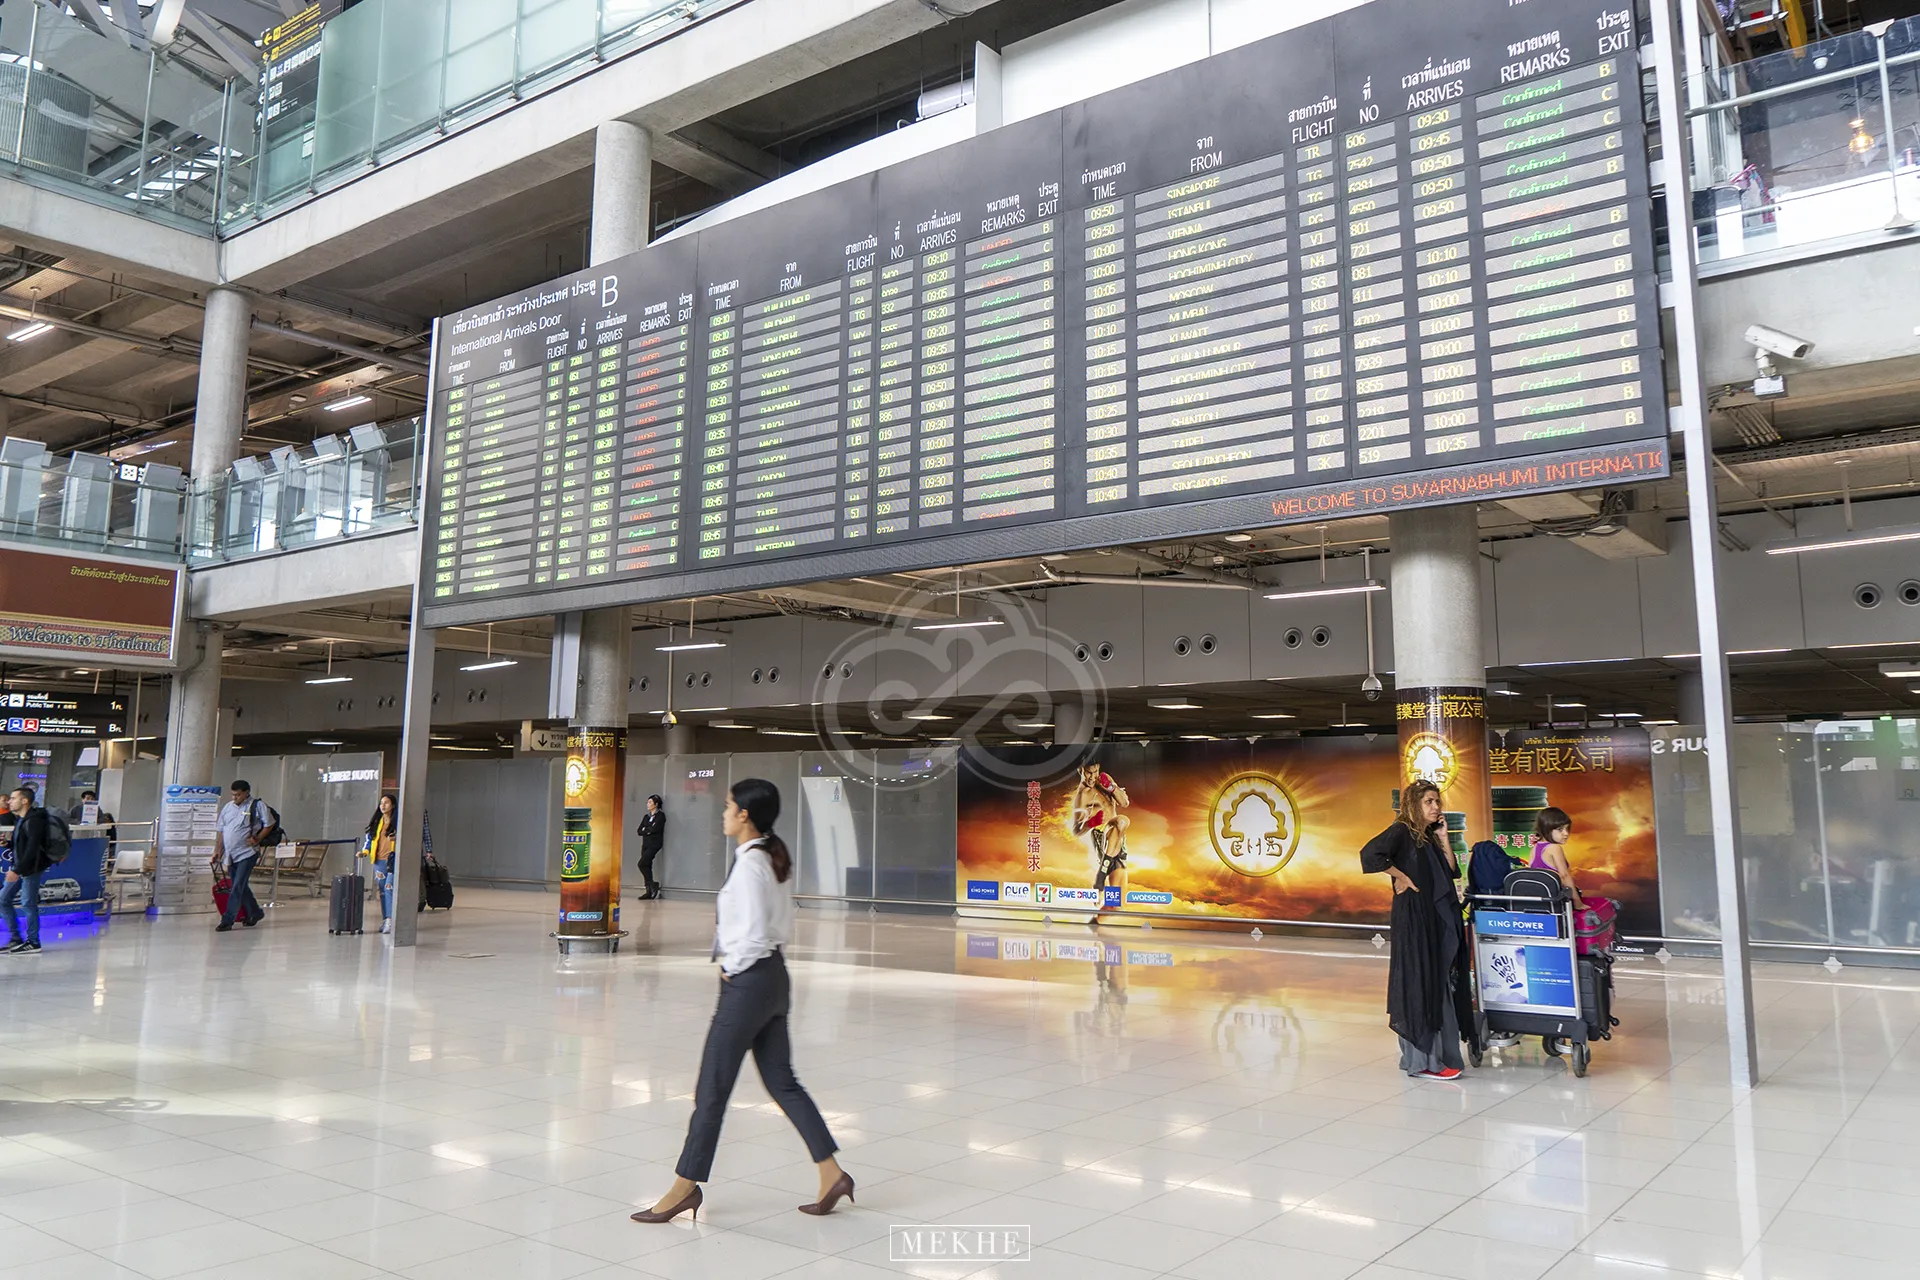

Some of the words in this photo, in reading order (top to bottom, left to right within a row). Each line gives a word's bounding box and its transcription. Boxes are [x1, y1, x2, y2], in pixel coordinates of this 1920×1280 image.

[1596, 9, 1630, 30] ประตู
[1507, 30, 1560, 58] หมายเหตุ
[1598, 30, 1631, 55] EXIT
[1500, 48, 1570, 84] REMARKS
[1406, 80, 1464, 110] ARRIVES
[1288, 95, 1337, 123] สายการบิน
[1359, 104, 1379, 124] NO
[1292, 117, 1334, 144] FLIGHT
[1090, 204, 1114, 221] 09:50
[1304, 146, 1320, 160] TR
[1346, 134, 1366, 149] 606
[1417, 110, 1449, 128] 09:30
[1599, 63, 1610, 78] B
[1196, 136, 1213, 150] จาก
[1090, 224, 1114, 240] 09:50
[1418, 132, 1450, 150] 09:45
[1601, 86, 1612, 101] C
[1190, 151, 1222, 172] FROM
[1038, 182, 1058, 198] ประตู
[1092, 244, 1115, 259] 10:00
[1419, 155, 1452, 173] 09:50
[1603, 111, 1614, 125] C
[1093, 182, 1116, 200] TIME
[1038, 199, 1059, 217] EXIT
[1092, 264, 1116, 279] 10:00
[1421, 178, 1453, 196] 09:50
[1605, 135, 1615, 149] C
[982, 209, 1026, 234] REMARKS
[1093, 284, 1116, 299] 10:05
[1350, 221, 1370, 237] 801
[1422, 200, 1454, 219] 09:50
[1607, 159, 1618, 174] B
[920, 229, 956, 251] ARRIVES
[890, 244, 904, 260] NO
[927, 253, 948, 266] 09:10
[847, 253, 876, 272] FLIGHT
[927, 271, 948, 284] 09:20
[1094, 324, 1116, 338] 10:10
[1427, 247, 1457, 264] 10:10
[1610, 209, 1621, 223] B
[572, 279, 596, 297] ประตู
[602, 275, 619, 308] B
[780, 275, 802, 292] FROM
[715, 295, 731, 310] TIME
[927, 289, 948, 302] 09:05
[678, 307, 693, 321] EXIT
[1093, 304, 1116, 319] 10:10
[1094, 345, 1116, 358] 10:15
[1427, 270, 1458, 286] 10:10
[640, 314, 670, 332] REMARKS
[452, 333, 502, 356] International
[504, 320, 537, 341] Arrivals
[540, 314, 562, 330] Door
[578, 338, 587, 350] NO
[597, 328, 623, 345] ARRIVES
[547, 344, 567, 359] FLIGHT
[500, 359, 516, 373] FROM
[452, 373, 465, 385] TIME
[1094, 488, 1118, 502] 10:40
[1436, 436, 1467, 453] 10:35
[1272, 492, 1355, 516] WELCOME
[1362, 487, 1386, 504] TO
[1392, 467, 1538, 502] SUVARNABHUMI
[8, 625, 73, 645] Welcome
[76, 634, 92, 646] to
[96, 632, 166, 652] Thailand
[1027, 780, 1041, 873] 泰拳王播求
[1005, 885, 1029, 897] pure
[1058, 890, 1076, 899] SAVE
[1106, 890, 1119, 899] P&F
[1132, 893, 1167, 902] watsons
[1488, 920, 1511, 928] KING
[1513, 921, 1544, 929] POWER
